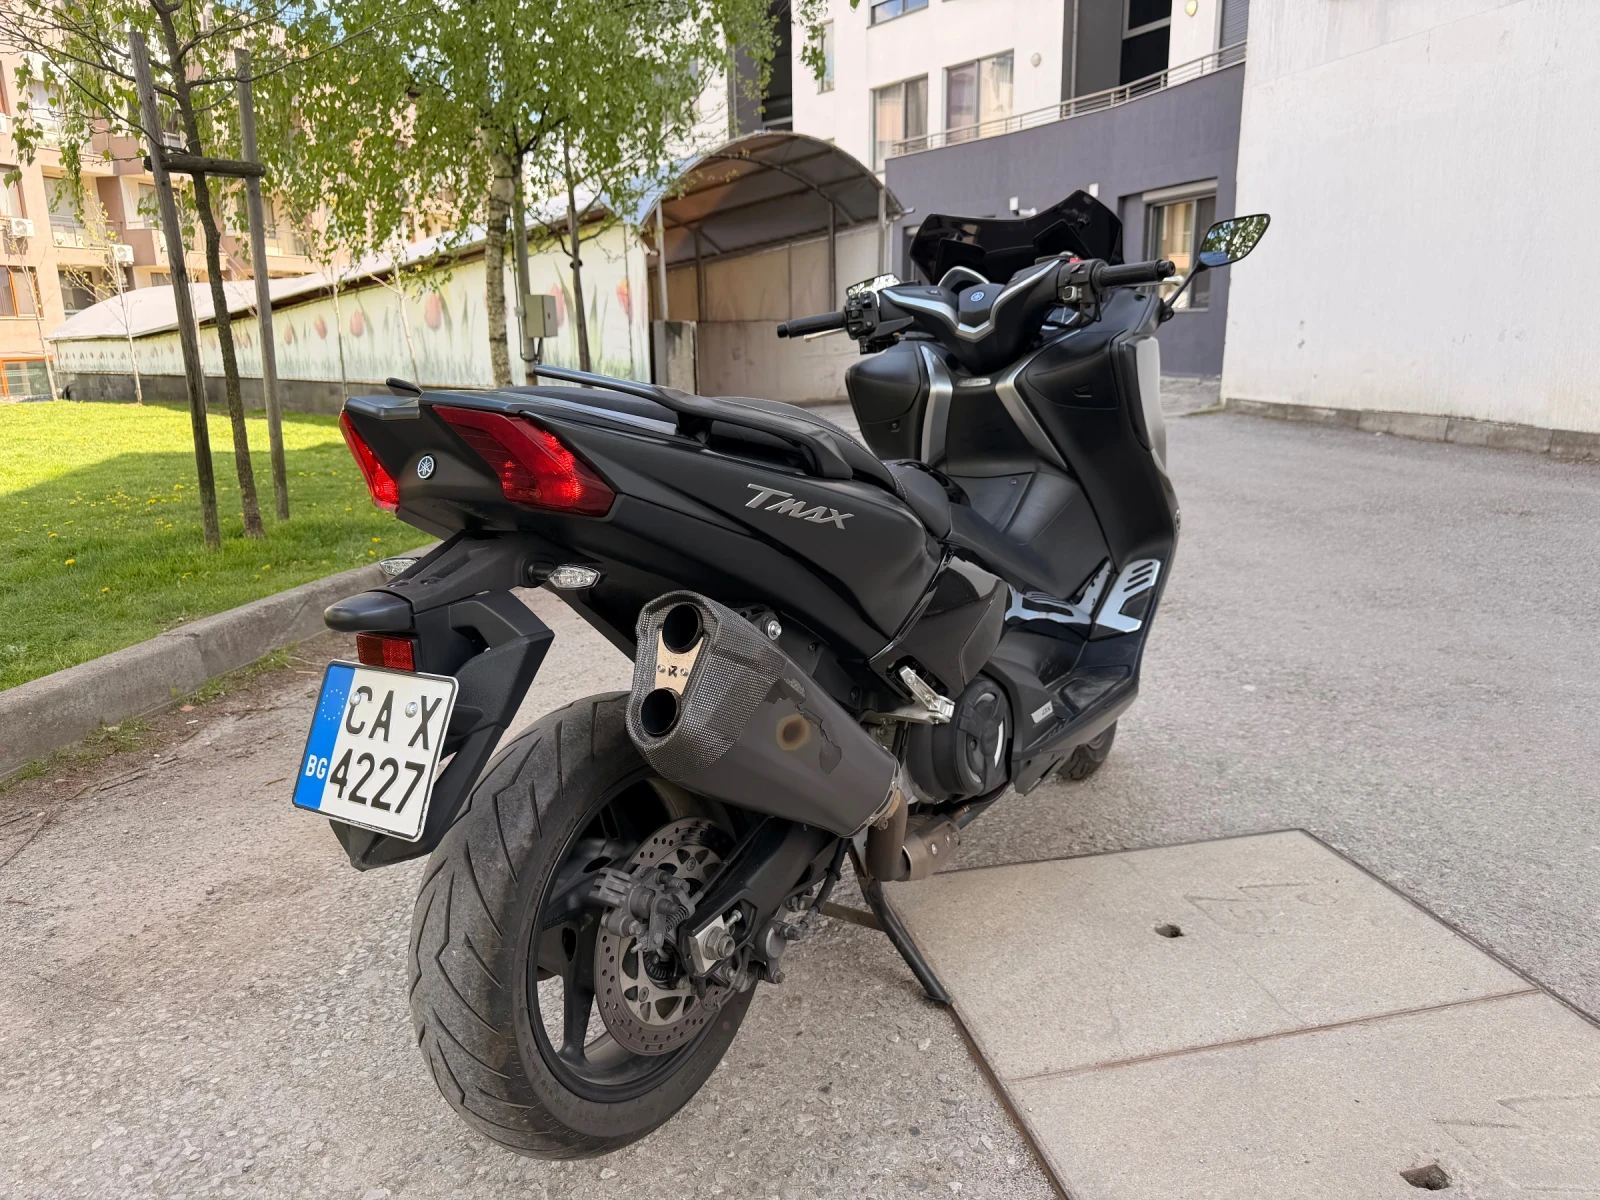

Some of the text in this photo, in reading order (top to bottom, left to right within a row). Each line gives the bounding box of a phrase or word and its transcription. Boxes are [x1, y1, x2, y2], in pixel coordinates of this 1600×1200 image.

[345, 685, 442, 751] CA X
[305, 754, 328, 779] BG
[329, 748, 426, 815] 4227
